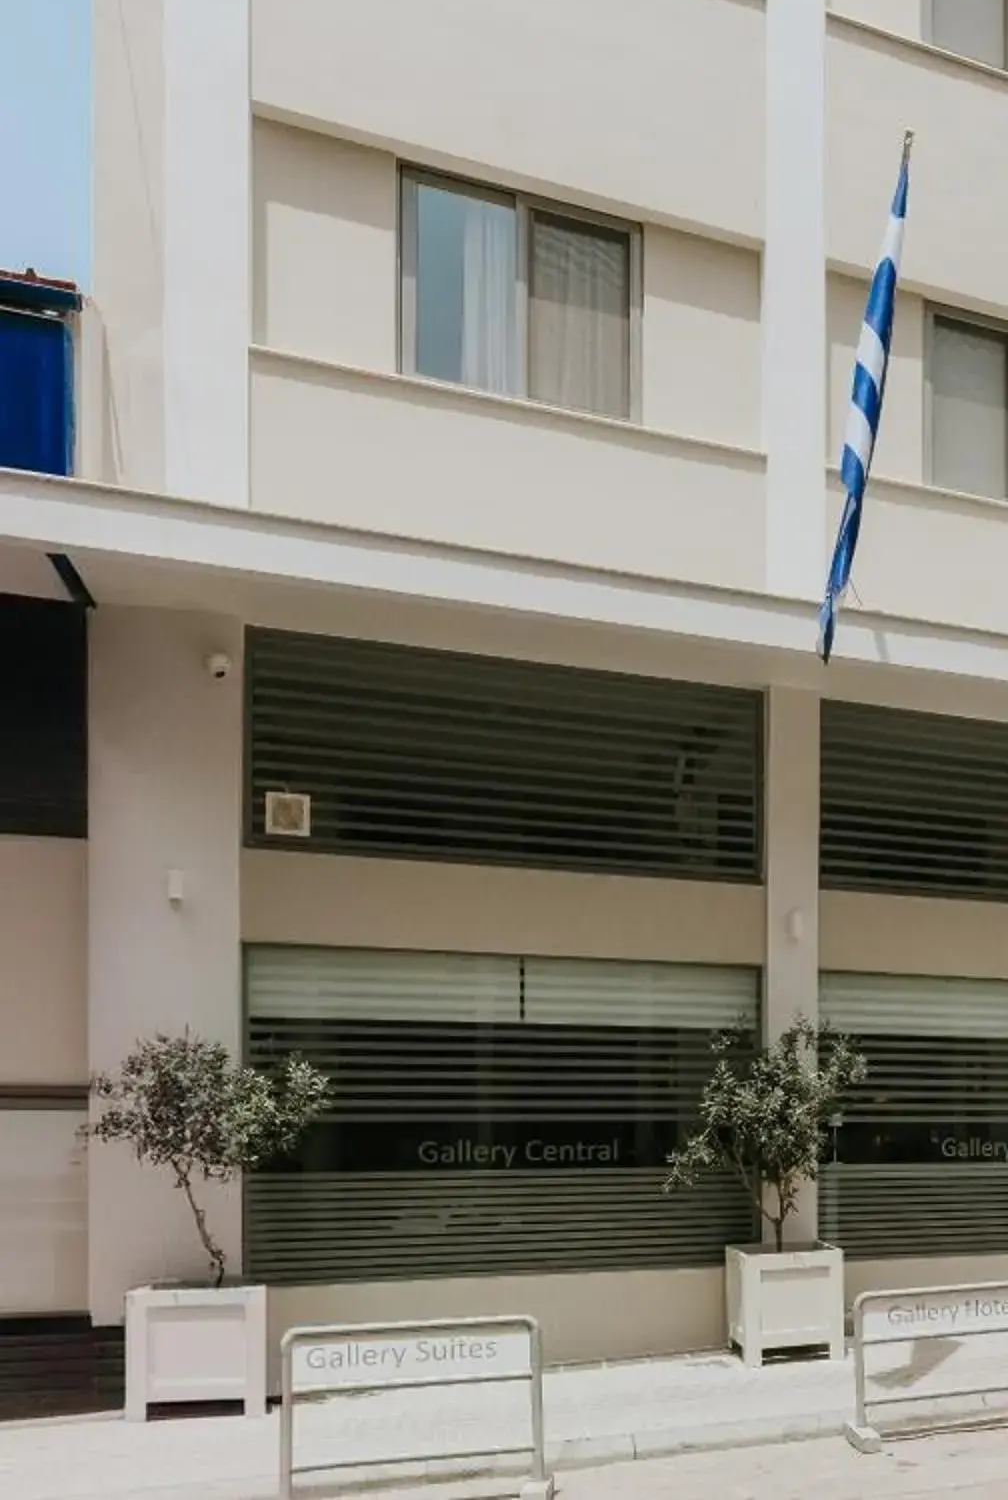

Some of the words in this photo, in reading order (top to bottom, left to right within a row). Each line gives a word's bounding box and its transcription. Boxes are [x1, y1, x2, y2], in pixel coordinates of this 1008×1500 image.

[418, 1139, 517, 1168] Gallery
[525, 1139, 619, 1162] Central
[887, 1302, 960, 1326] Gallery
[306, 1344, 407, 1369] Gallery
[415, 1339, 498, 1362] Suites
